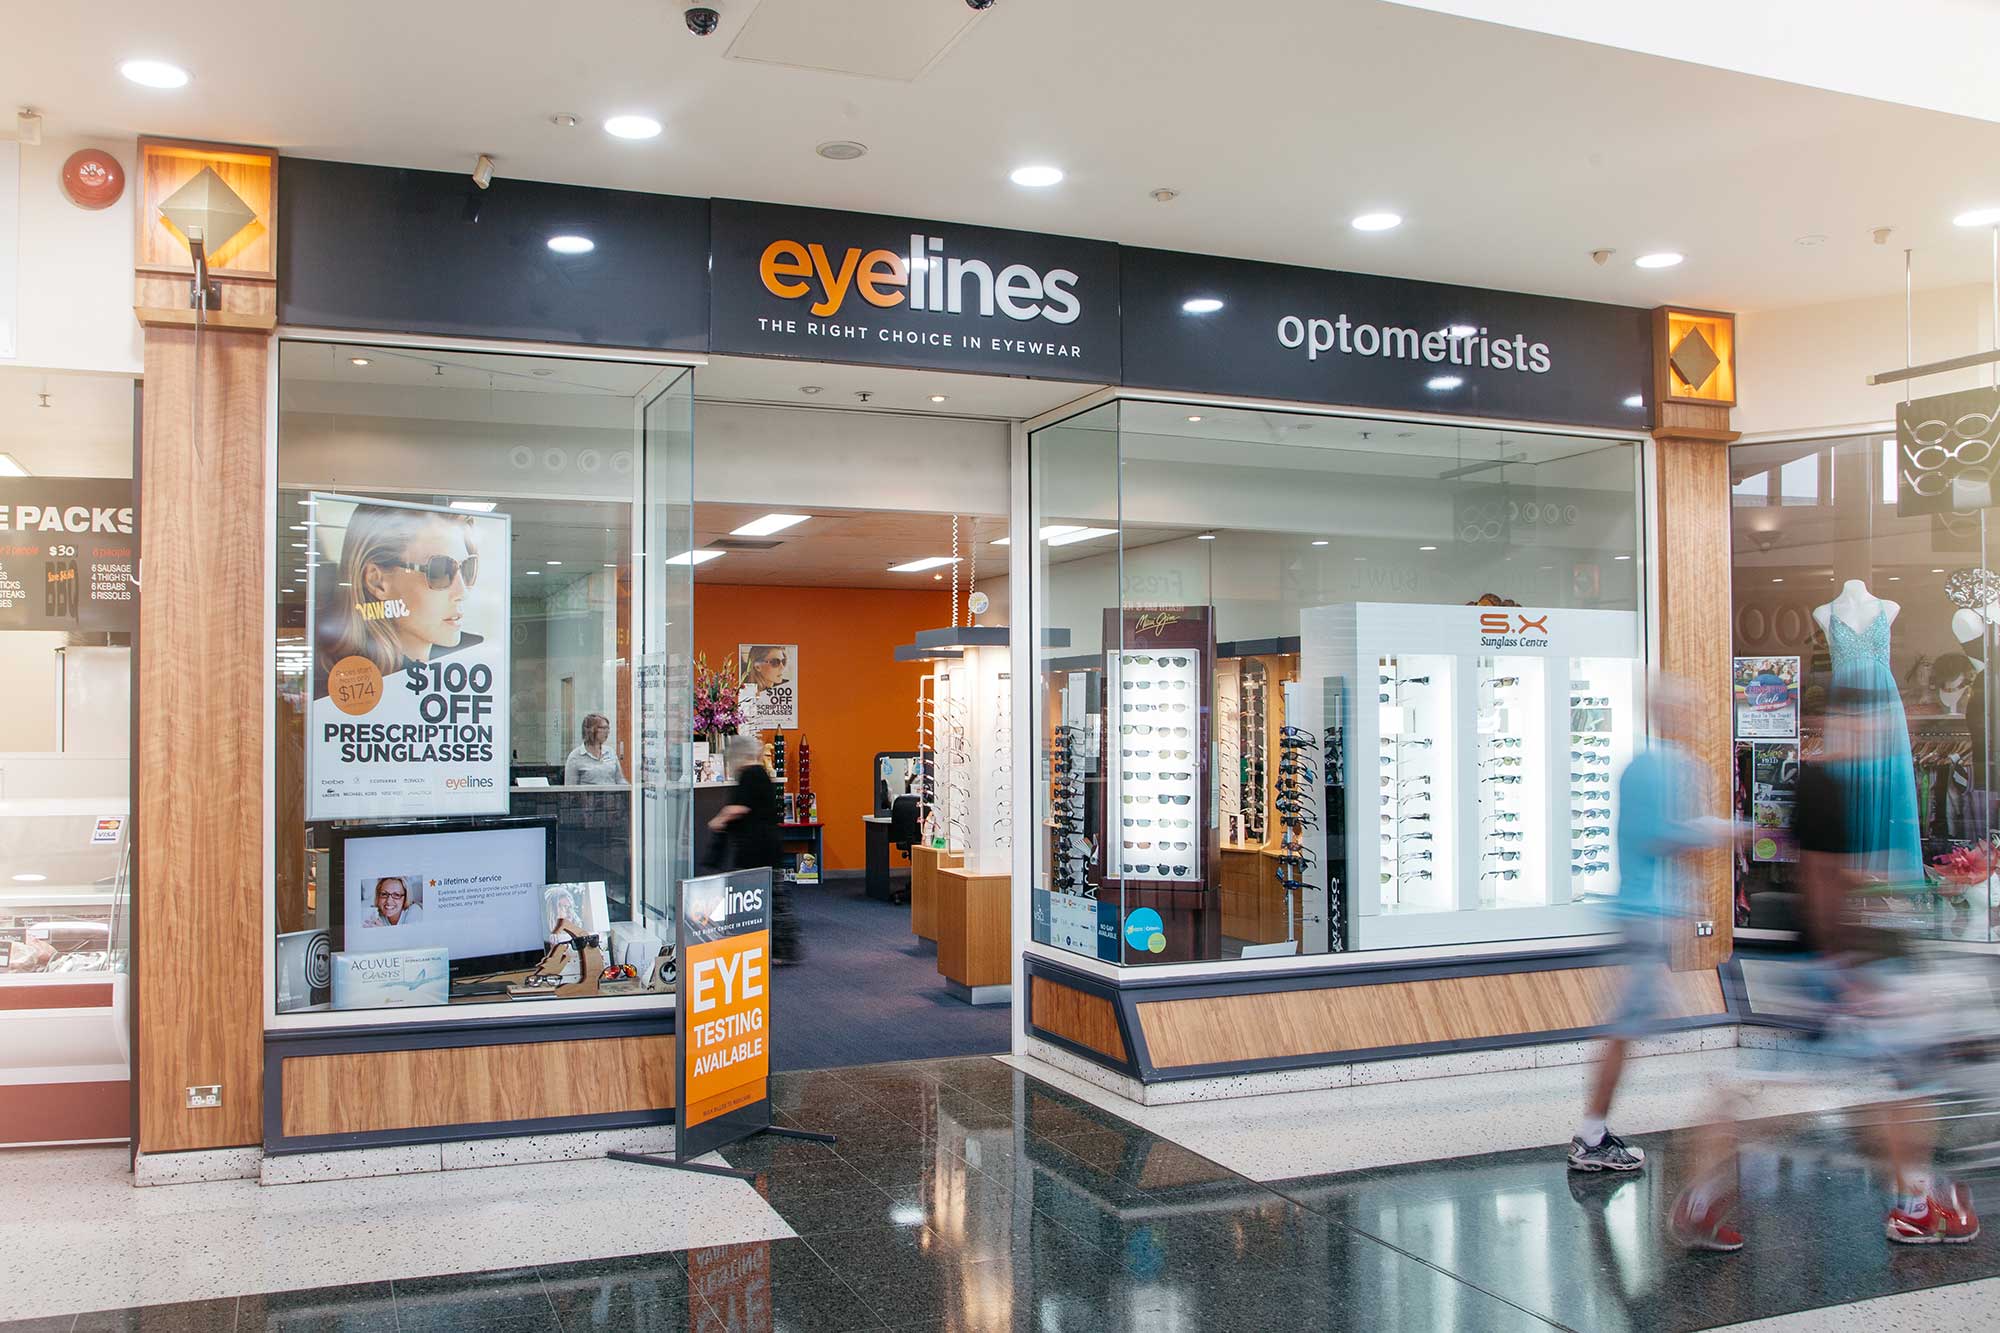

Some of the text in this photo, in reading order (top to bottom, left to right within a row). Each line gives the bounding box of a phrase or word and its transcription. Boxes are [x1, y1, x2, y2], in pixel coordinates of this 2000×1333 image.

[759, 234, 1081, 324] eyelines
[758, 318, 1081, 358] THE RIGHT CHOICE IN EYEWEAR
[1277, 313, 1551, 373] optometrists
[16, 505, 133, 534] PACKS
[49, 545, 75, 557] $30
[97, 582, 127, 591] KEBABS
[97, 591, 131, 600] RISSOLES
[1480, 635, 1549, 649] Sunglass Centre
[405, 659, 493, 695] $100
[339, 682, 376, 702] $174
[766, 687, 792, 697] $100
[770, 697, 793, 705] OFF
[419, 693, 493, 724] OFF
[324, 723, 493, 743] PRESCRIPTION
[341, 743, 493, 763] SUNGLASSES
[446, 775, 494, 791] eyelines
[443, 877, 469, 885] lifetime
[351, 957, 401, 971] ACUVUE
[693, 947, 763, 1014] EYE
[693, 1007, 763, 1049] TESTING
[693, 1037, 762, 1078] AVAILABLE
